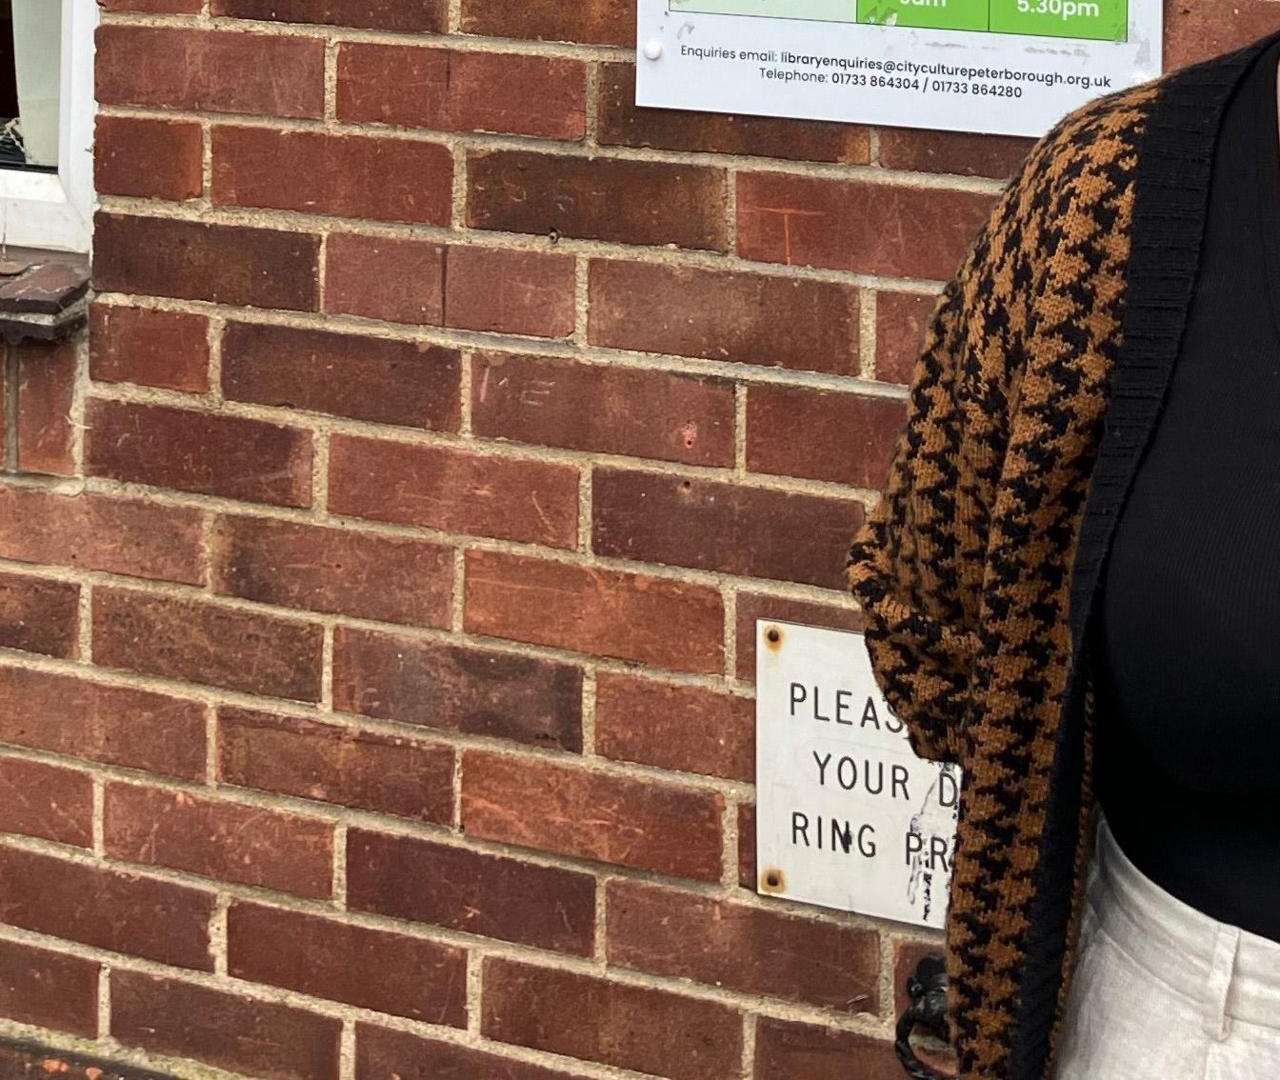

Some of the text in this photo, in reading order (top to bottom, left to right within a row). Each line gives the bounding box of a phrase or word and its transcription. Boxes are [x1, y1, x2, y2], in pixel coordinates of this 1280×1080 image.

[681, 45, 1112, 89] Enquiries email: libraryenquiries@cityculturepeterborough.org.uk
[760, 66, 1022, 98] Telephone: 01733 864304 / 01733 864280
[790, 682, 905, 733] PLEAS
[813, 751, 957, 807] YOUR D
[792, 812, 948, 873] RING PR
